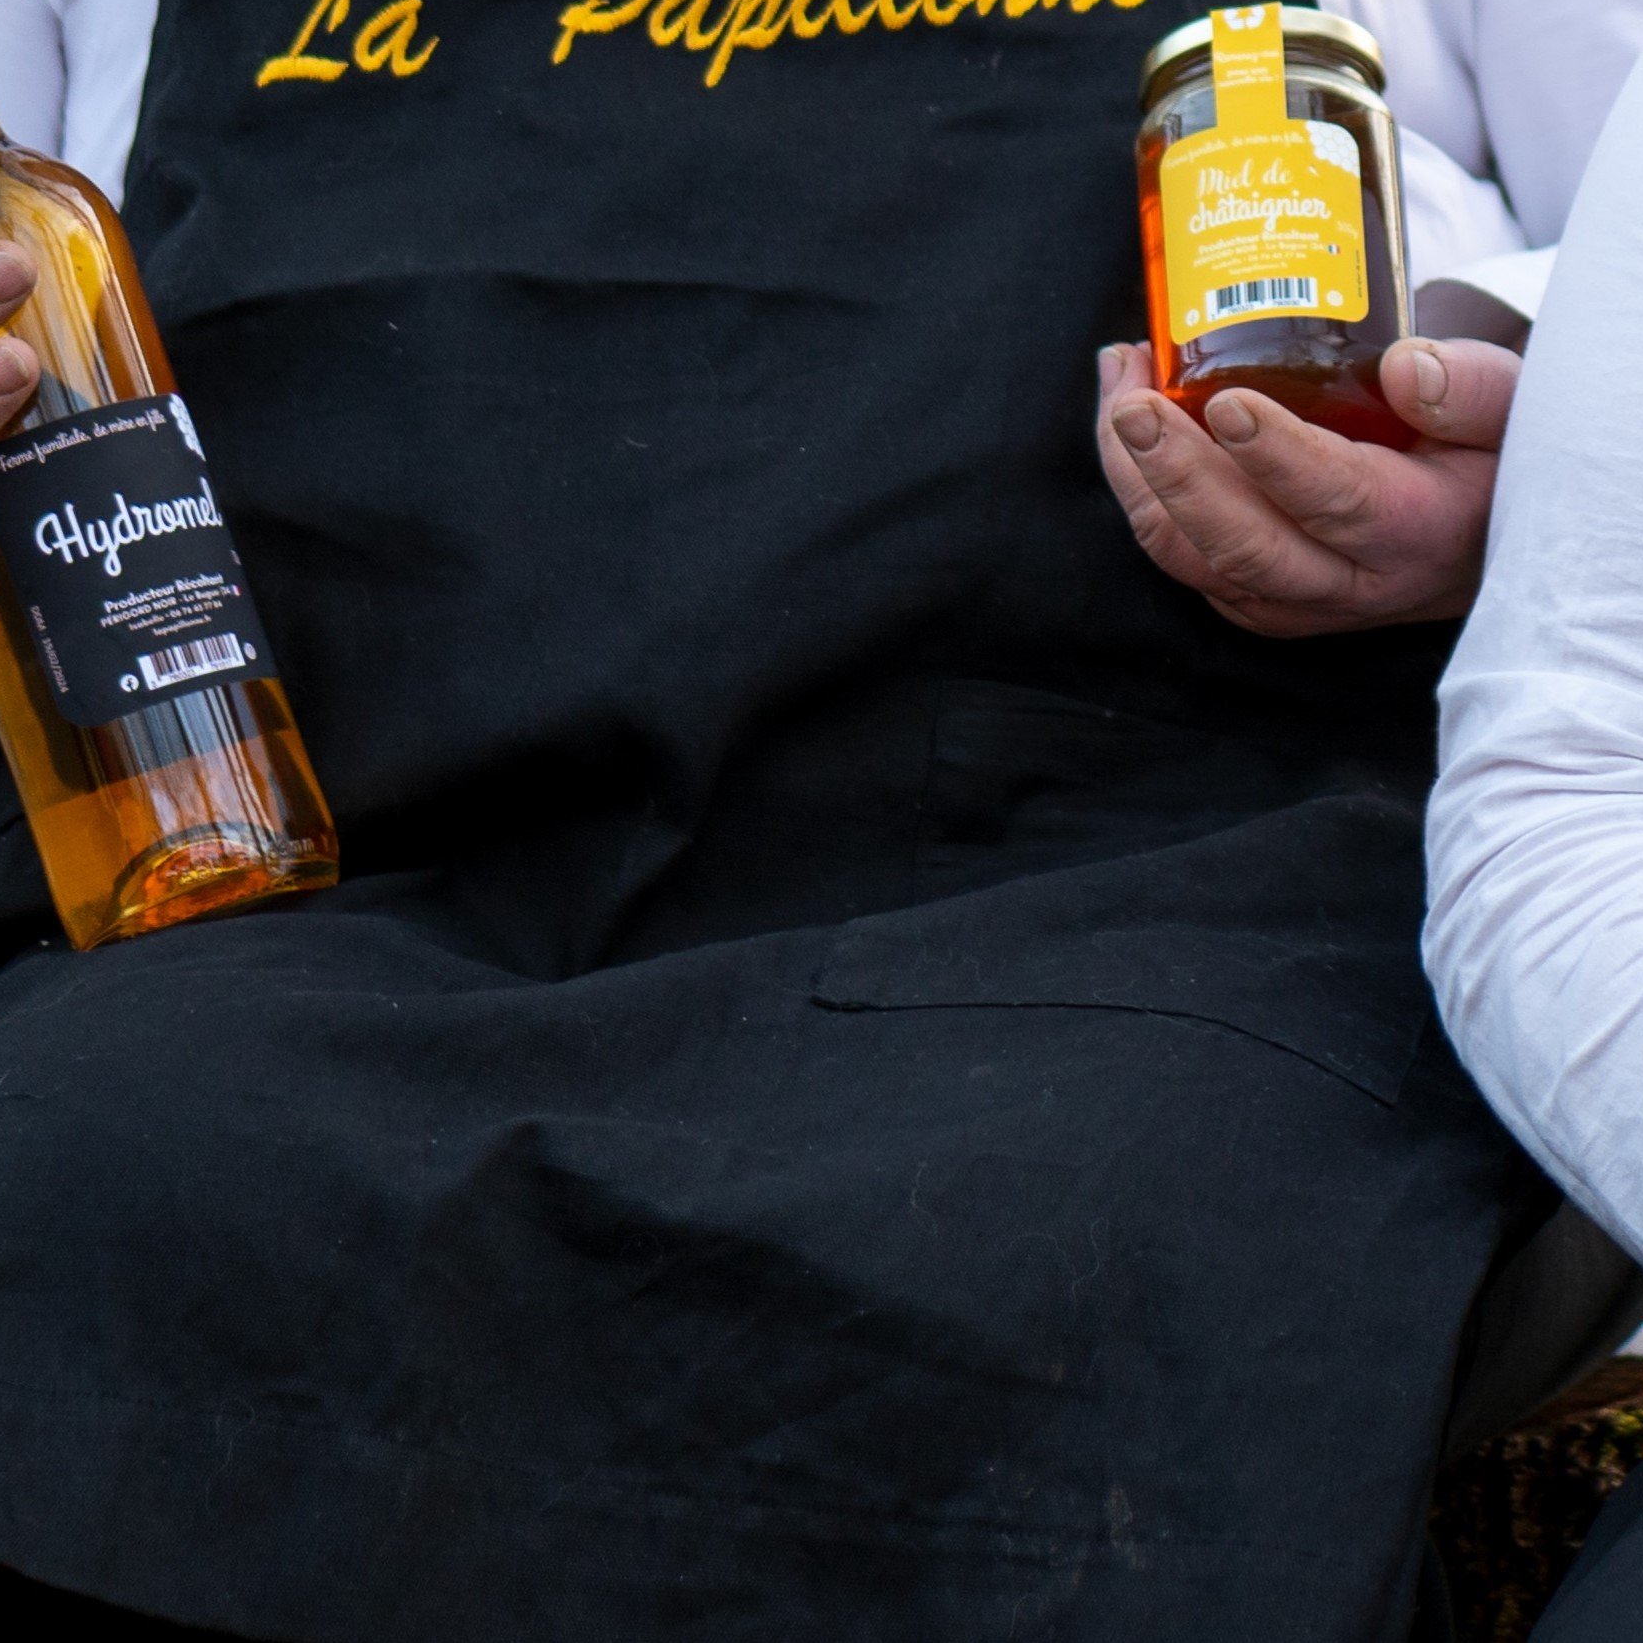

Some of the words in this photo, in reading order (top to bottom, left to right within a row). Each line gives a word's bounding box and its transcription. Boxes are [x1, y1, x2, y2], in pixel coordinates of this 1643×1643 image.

[1197, 158, 1253, 199] Miel
[1262, 157, 1293, 185] de
[1188, 190, 1332, 233] châtaignier
[93, 422, 108, 438] de
[34, 475, 224, 577] Hydromel
[103, 584, 175, 613] Producteur
[174, 572, 224, 593] Récoltant
[151, 596, 177, 611] NOIR
